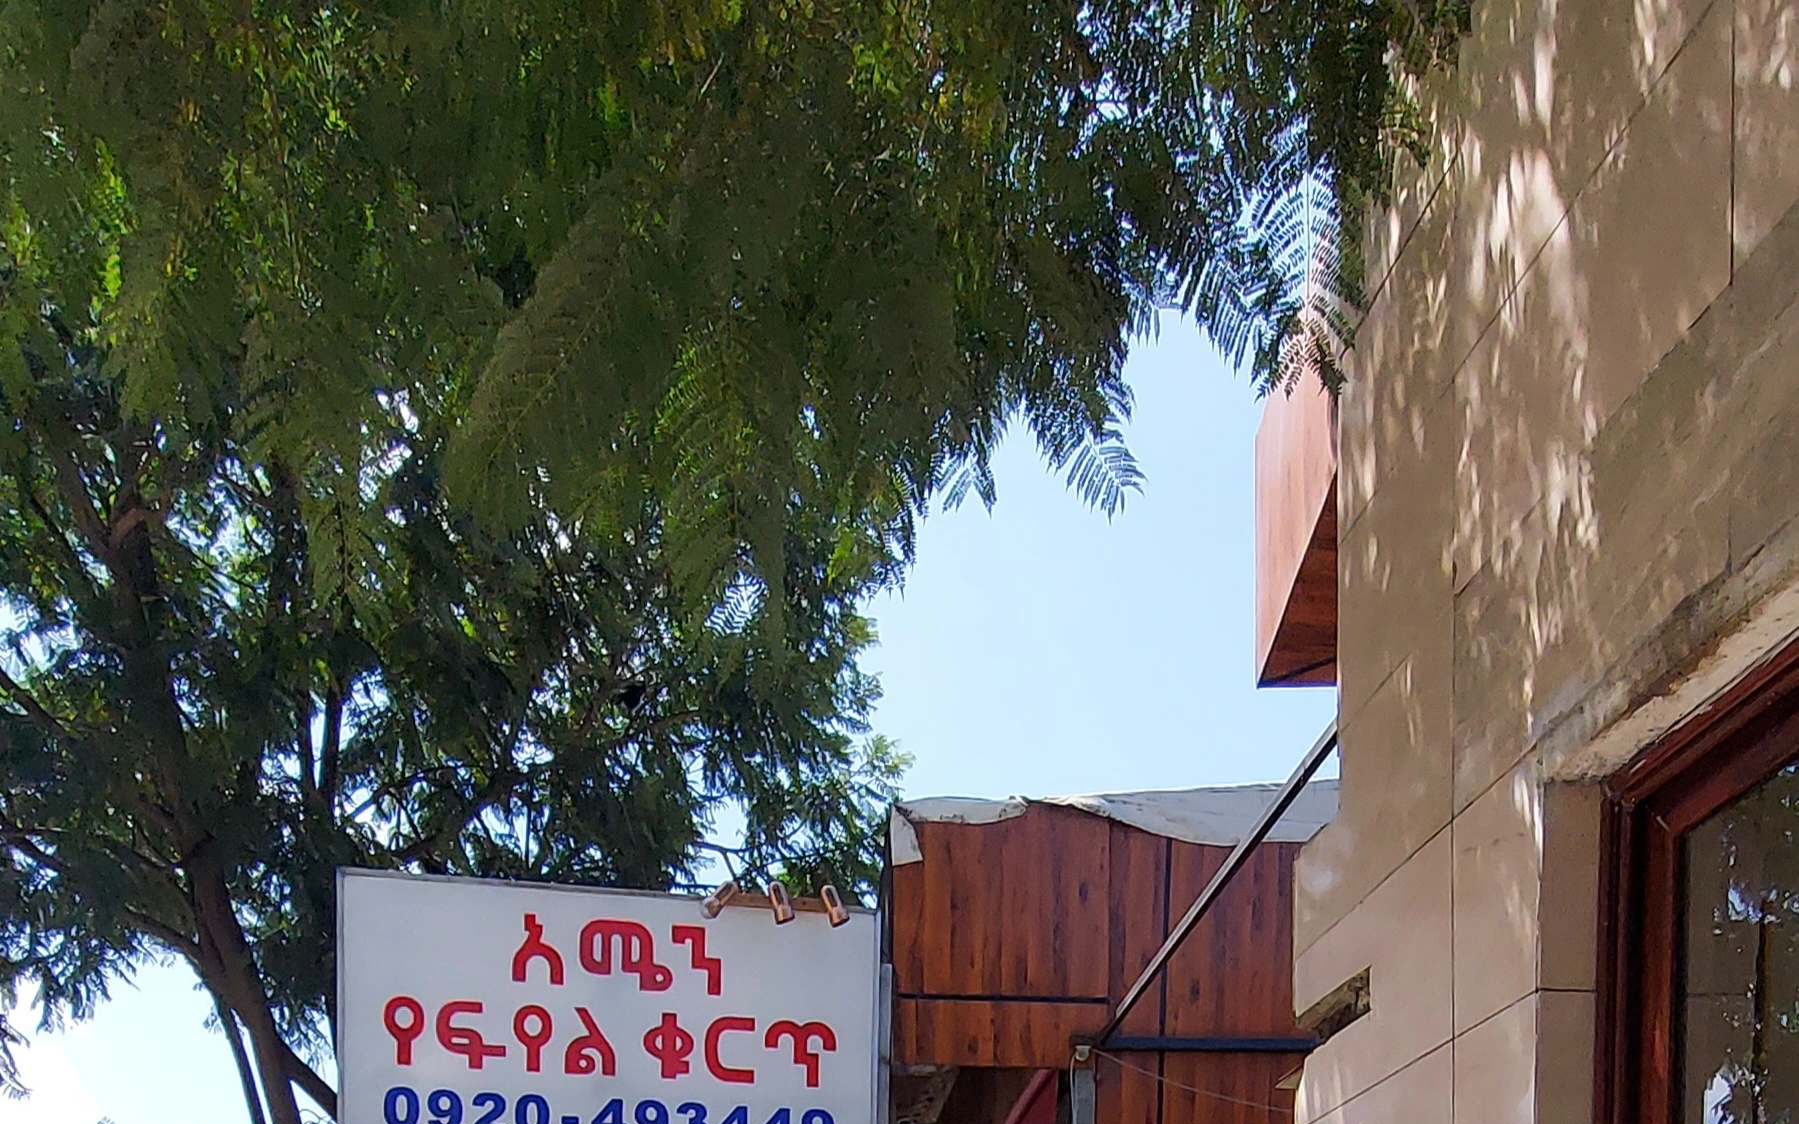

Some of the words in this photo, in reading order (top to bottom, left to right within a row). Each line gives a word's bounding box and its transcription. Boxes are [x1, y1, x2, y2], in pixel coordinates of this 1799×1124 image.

[512, 912, 722, 996] አሜን
[382, 995, 615, 1076] የፍየል
[642, 1013, 837, 1087] ቁርጥ
